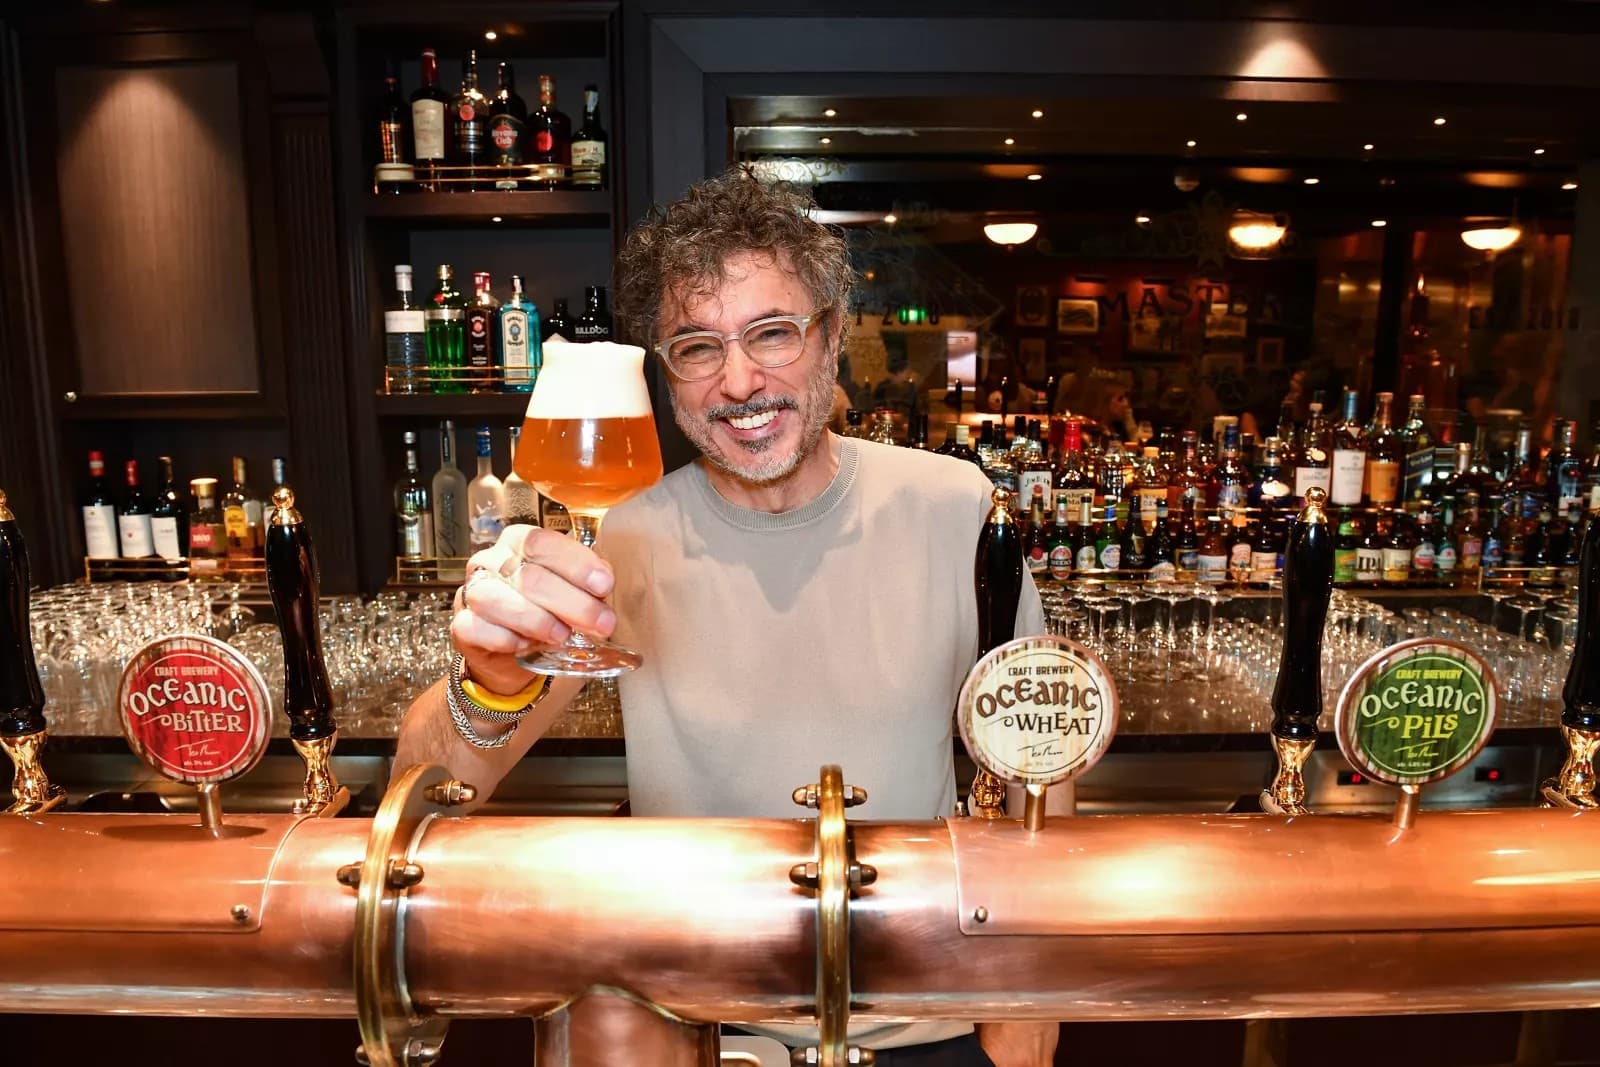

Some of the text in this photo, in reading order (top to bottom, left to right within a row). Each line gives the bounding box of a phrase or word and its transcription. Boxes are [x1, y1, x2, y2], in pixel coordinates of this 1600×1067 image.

[154, 666, 220, 677] CRAFT BREWERY
[1008, 665, 1075, 676] CRAFT BREWERY
[1396, 669, 1463, 680] CRAFT BREWERY
[1015, 712, 1095, 736] WHEAT
